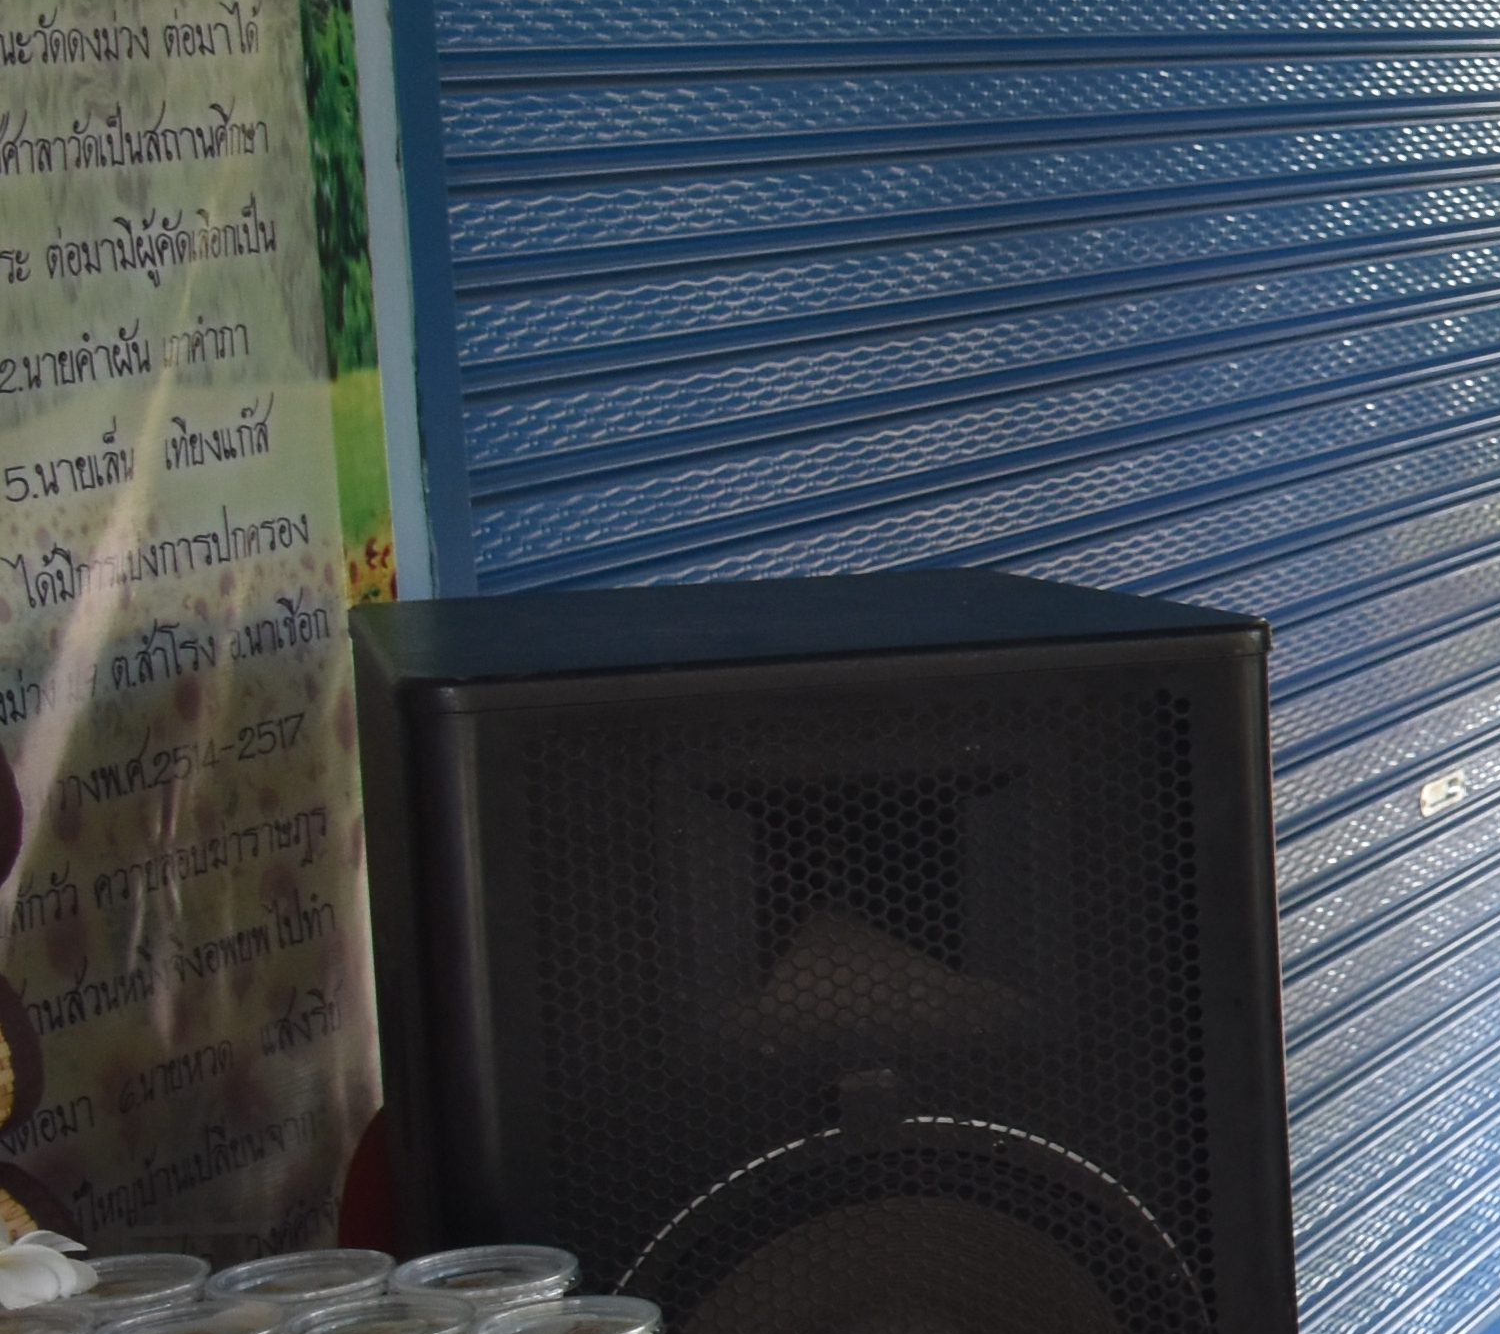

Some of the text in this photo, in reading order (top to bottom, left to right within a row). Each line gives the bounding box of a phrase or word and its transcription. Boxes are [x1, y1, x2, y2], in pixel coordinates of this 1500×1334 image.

[0, 95, 269, 177] ศาลาวัดเป็นสถานศึกษา
